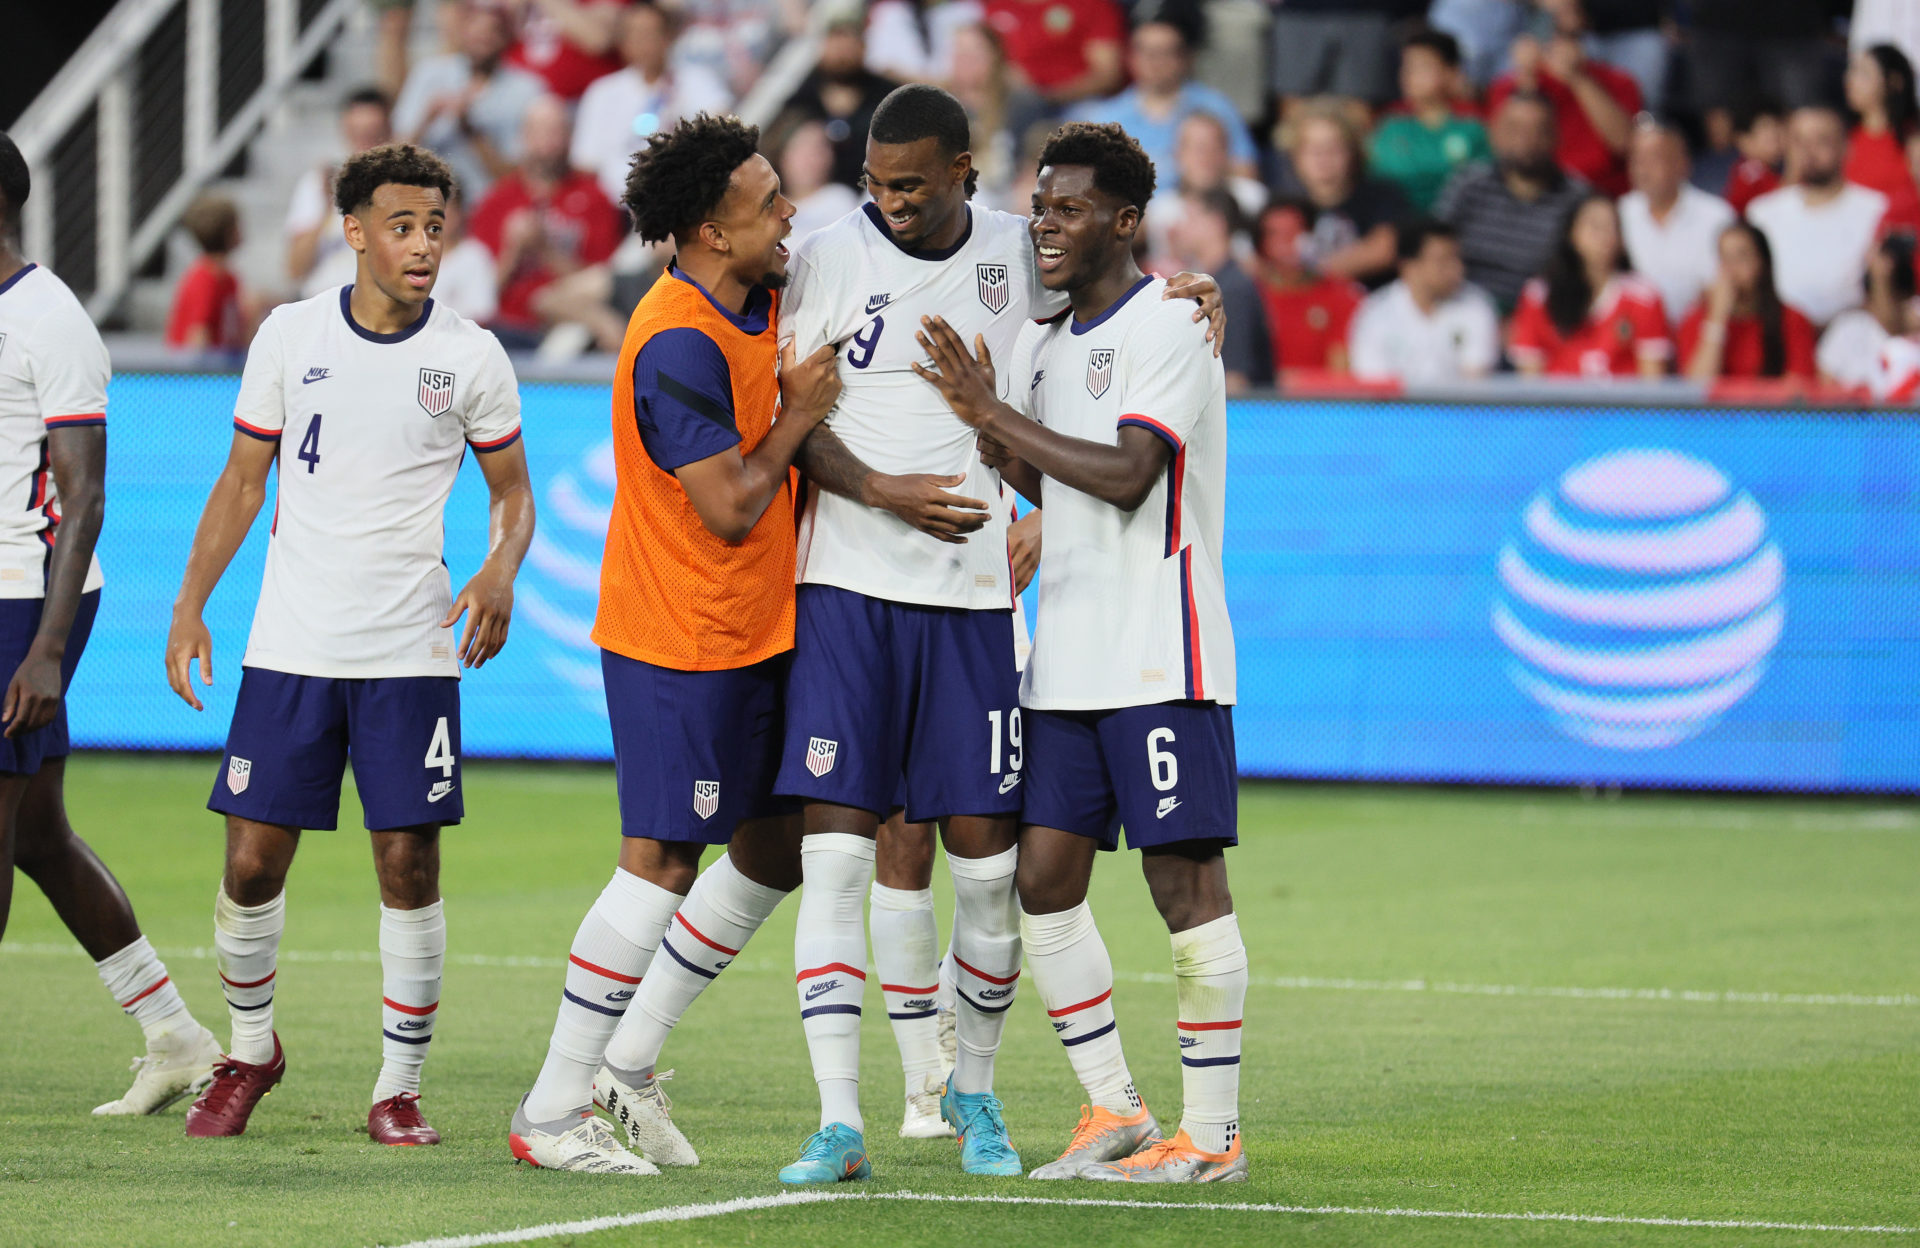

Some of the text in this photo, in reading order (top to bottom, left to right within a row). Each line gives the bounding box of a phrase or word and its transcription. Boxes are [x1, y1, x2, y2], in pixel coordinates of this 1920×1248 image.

[980, 267, 1005, 285] USA
[869, 293, 891, 306] NIKE
[847, 314, 885, 369] 9
[1091, 353, 1111, 370] USA
[307, 367, 329, 377] NIKE
[423, 372, 451, 390] USA
[298, 413, 322, 474] 4
[424, 716, 455, 777] 4
[811, 739, 835, 755] USA
[988, 707, 1023, 774] 19
[231, 758, 249, 774] USA
[1146, 726, 1178, 791] 6
[431, 780, 452, 793] NIKE
[1002, 772, 1019, 785] NIKE
[697, 782, 718, 797] USA
[1158, 796, 1177, 810] NIKE
[810, 979, 838, 992] NIKE
[1179, 1036, 1197, 1044] NIKE
